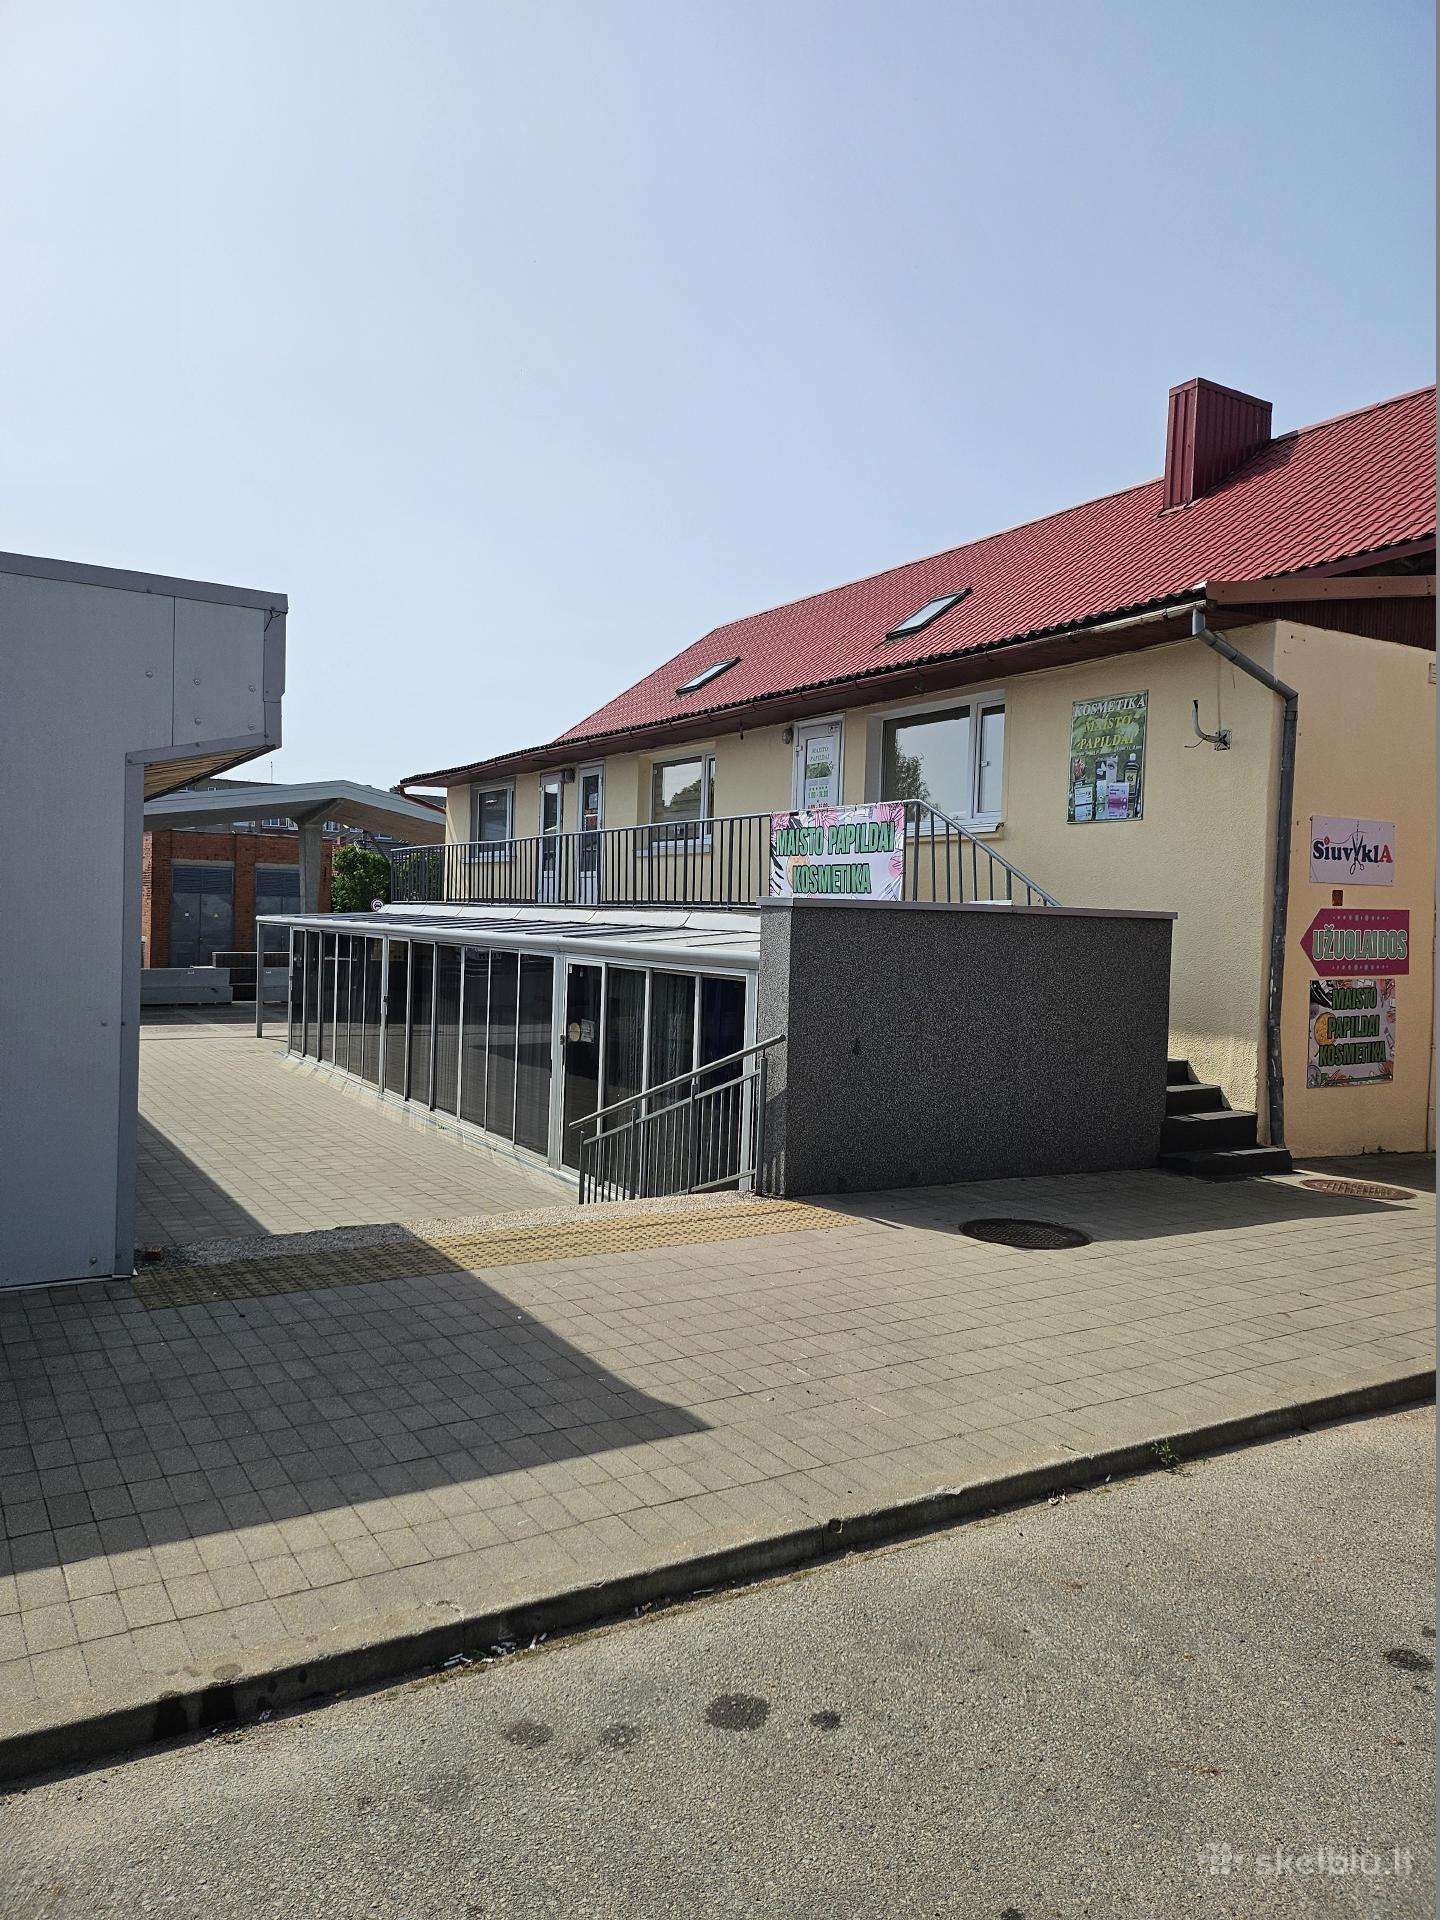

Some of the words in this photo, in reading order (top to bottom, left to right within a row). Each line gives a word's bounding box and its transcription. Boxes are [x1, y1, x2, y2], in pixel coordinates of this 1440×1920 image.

[1074, 696, 1147, 718] KOSMETIKA
[1084, 715, 1132, 733] MAISTO
[1077, 734, 1135, 750] PAPILDAI
[776, 826, 824, 857] MAISTO
[827, 821, 896, 856] PAPILDAI
[792, 863, 872, 894] KOSMETIKA
[1312, 924, 1408, 961] UŽUOLAIDOS
[1331, 987, 1378, 1011] MAISTO
[1326, 1015, 1381, 1039] PAPILDAI
[1318, 1041, 1387, 1067] KOSMETIKA
